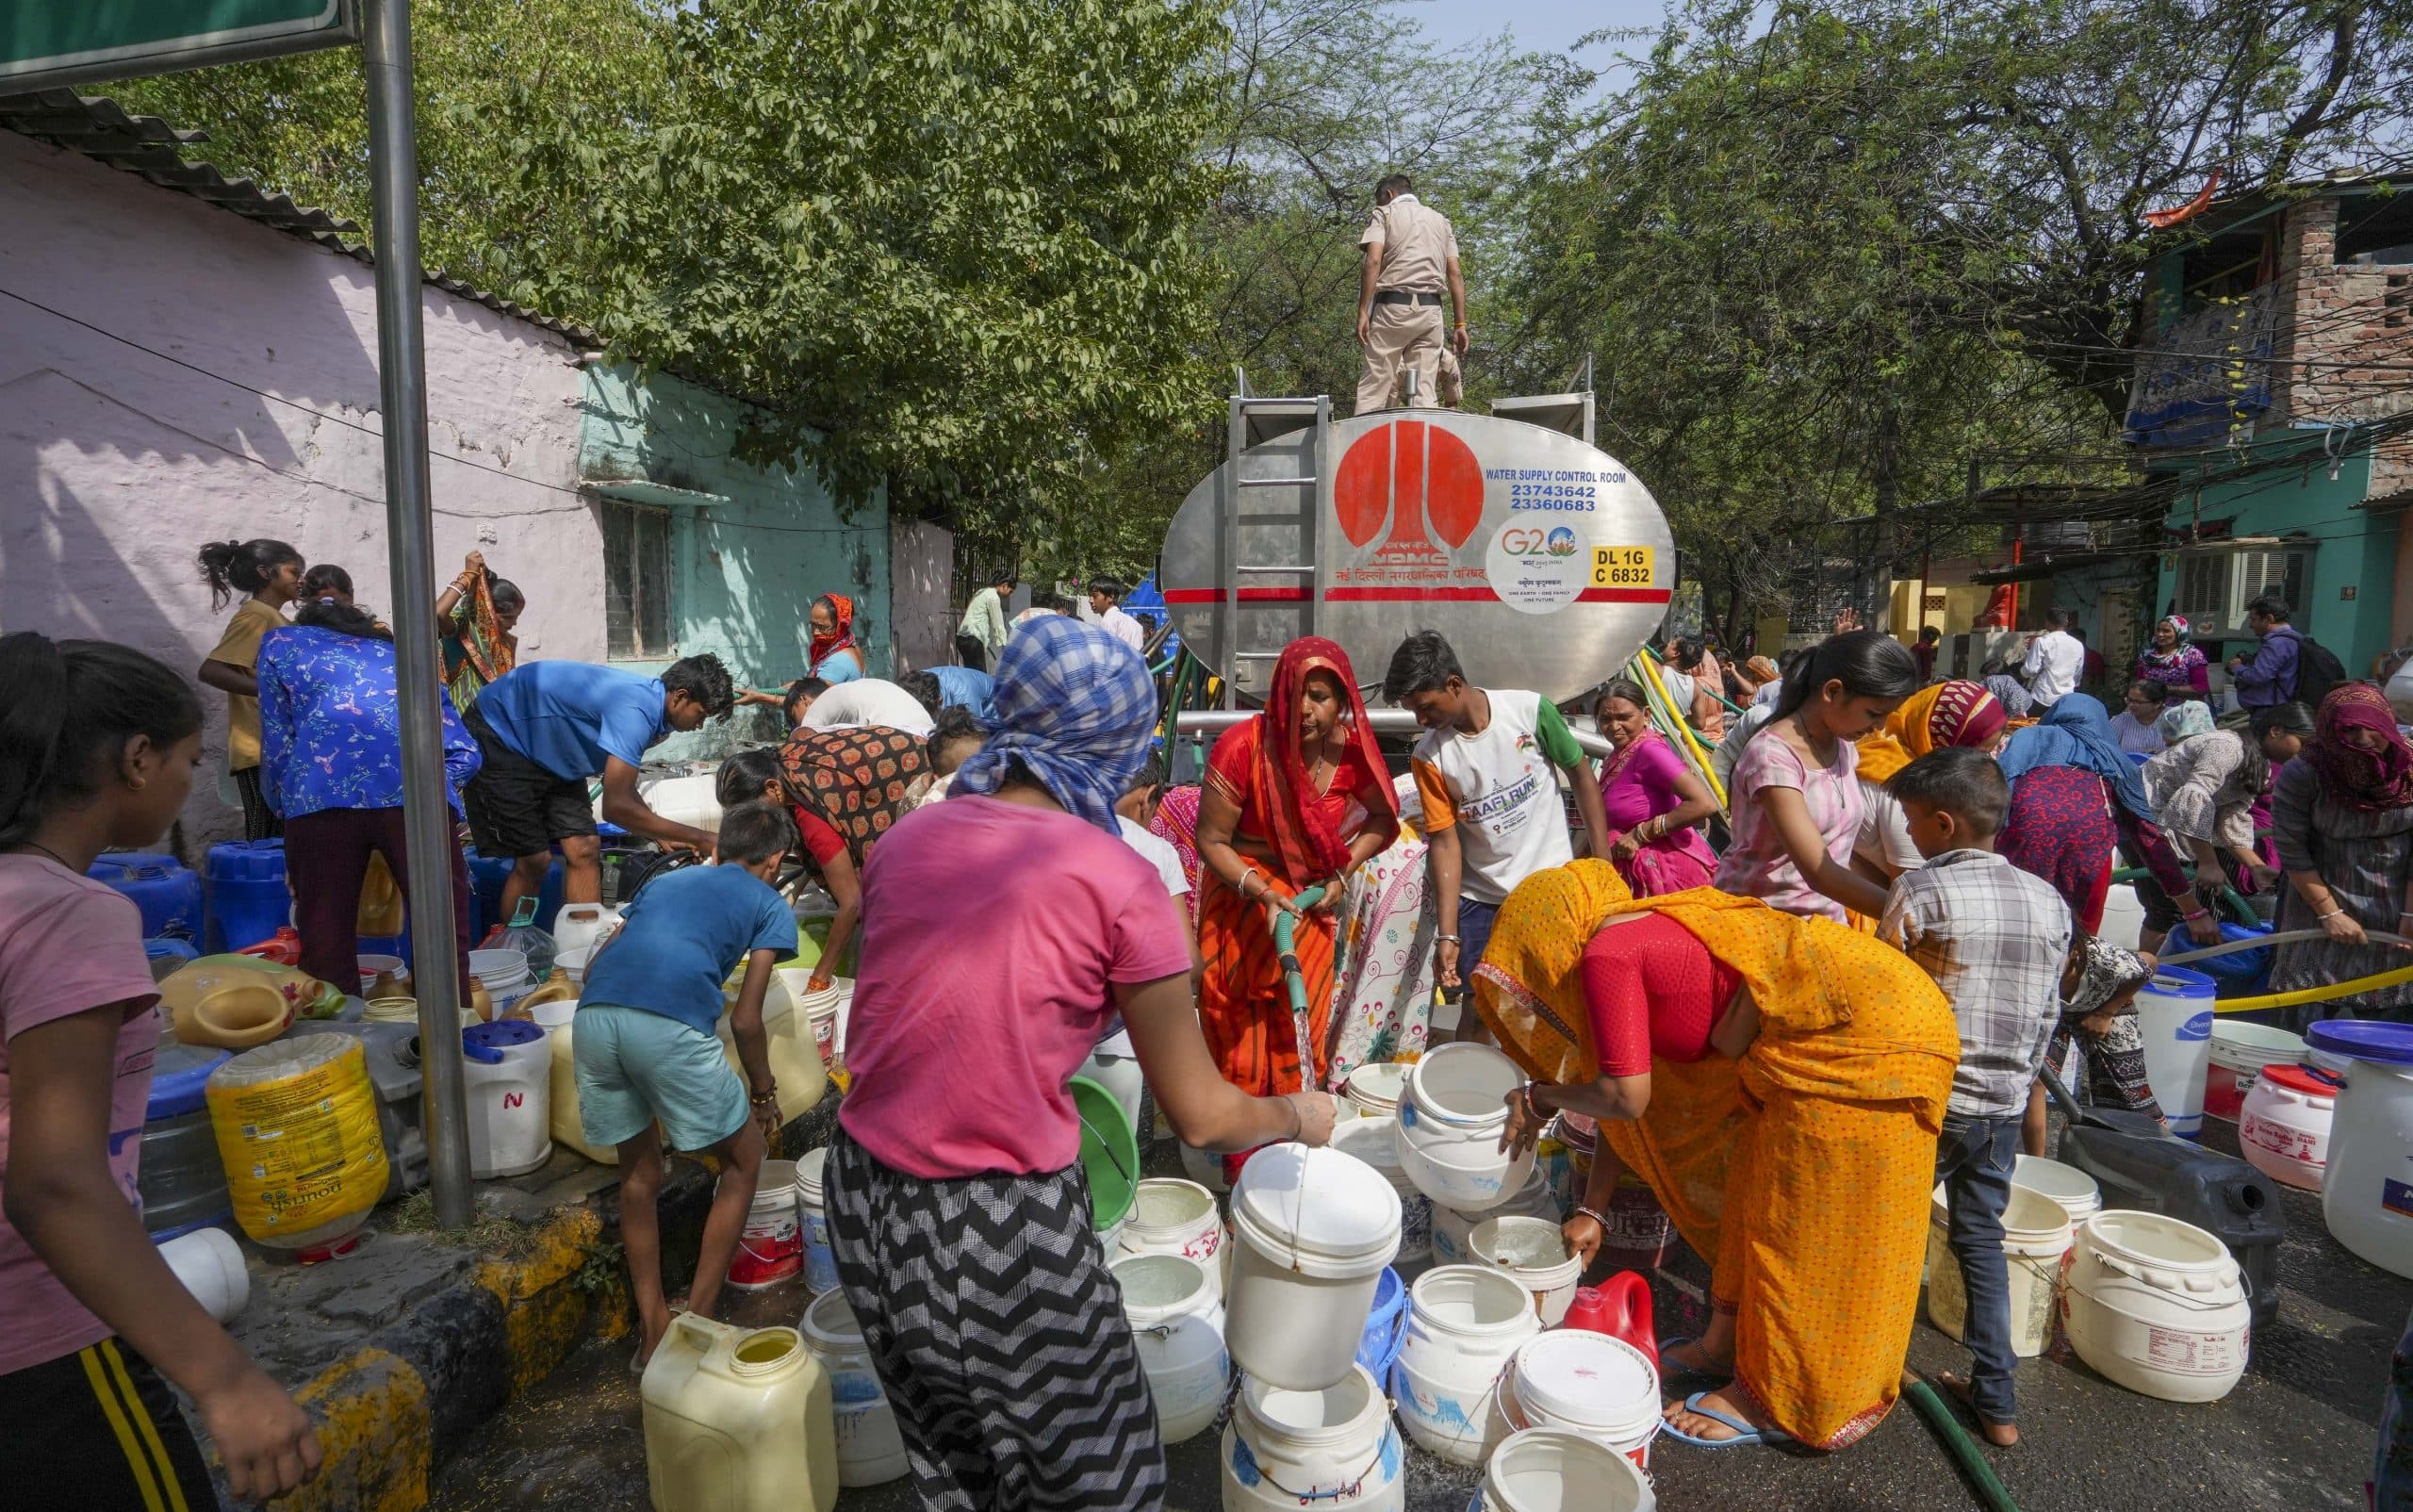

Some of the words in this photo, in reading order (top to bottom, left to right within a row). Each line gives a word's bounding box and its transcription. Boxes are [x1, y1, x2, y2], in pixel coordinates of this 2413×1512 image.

[1486, 468, 1517, 481] WATER
[1519, 469, 1553, 482] SUPPLY
[1555, 470, 1597, 483] CONTROL
[1600, 472, 1627, 484] ROOM
[1511, 484, 1596, 498] 23743642
[1511, 498, 1596, 512] 23360683
[1598, 550, 1618, 566] DL
[1623, 550, 1645, 566] 1G
[1595, 567, 1606, 583] C
[1611, 567, 1650, 583] 6832
[1509, 777, 1536, 803] RUN
[503, 1093, 523, 1109] N
[271, 1183, 342, 1214] nourish
